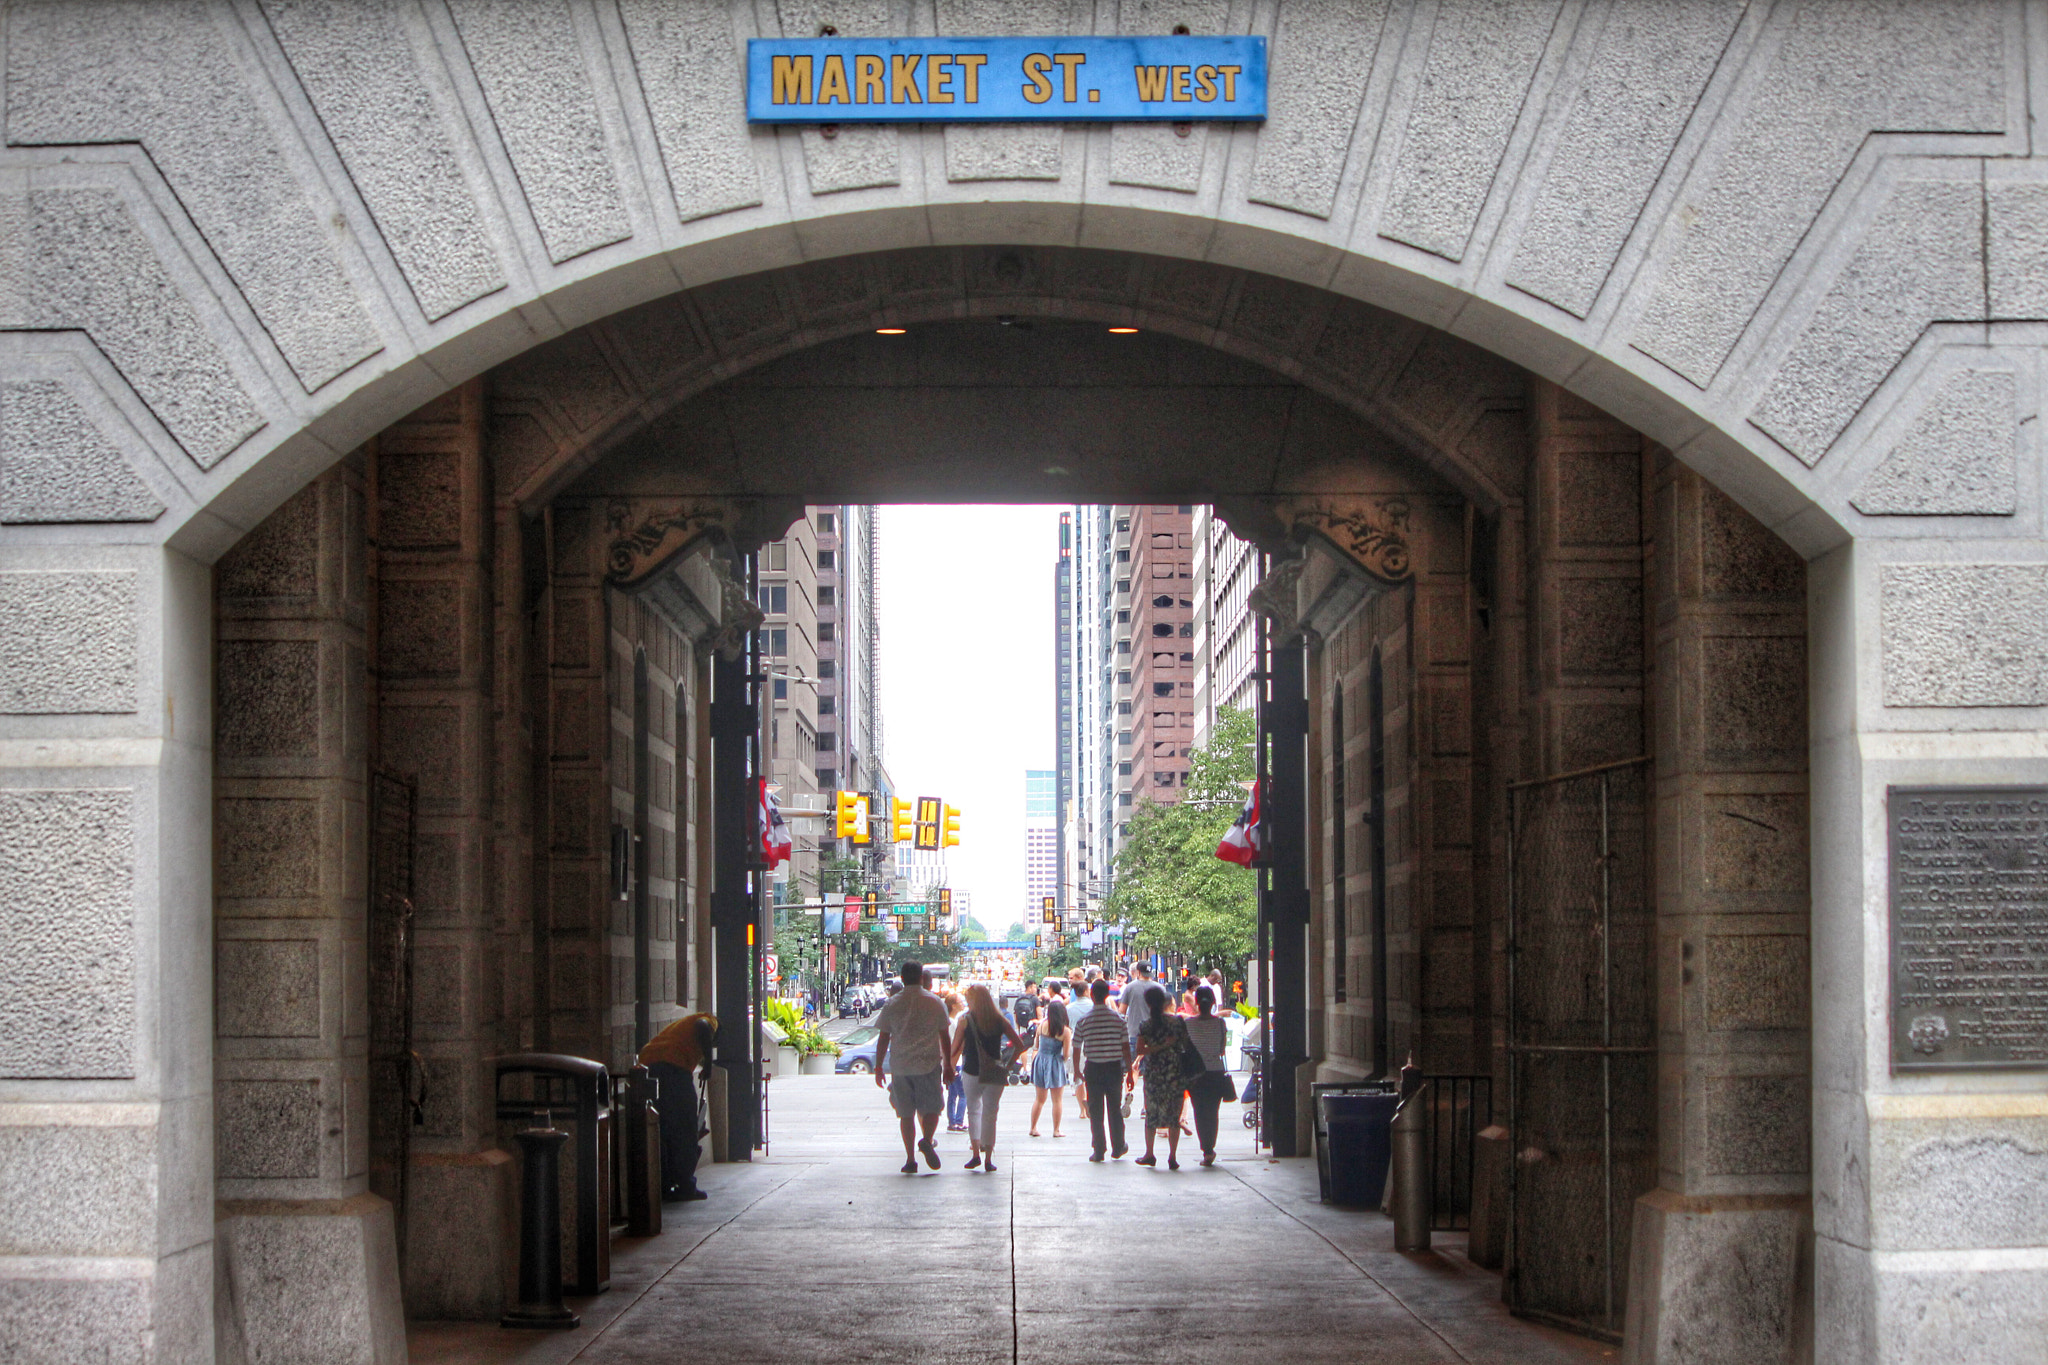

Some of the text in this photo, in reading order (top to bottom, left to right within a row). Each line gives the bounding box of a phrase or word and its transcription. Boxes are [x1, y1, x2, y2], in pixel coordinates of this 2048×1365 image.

[771, 53, 1242, 104] MARKET ST. WEST
